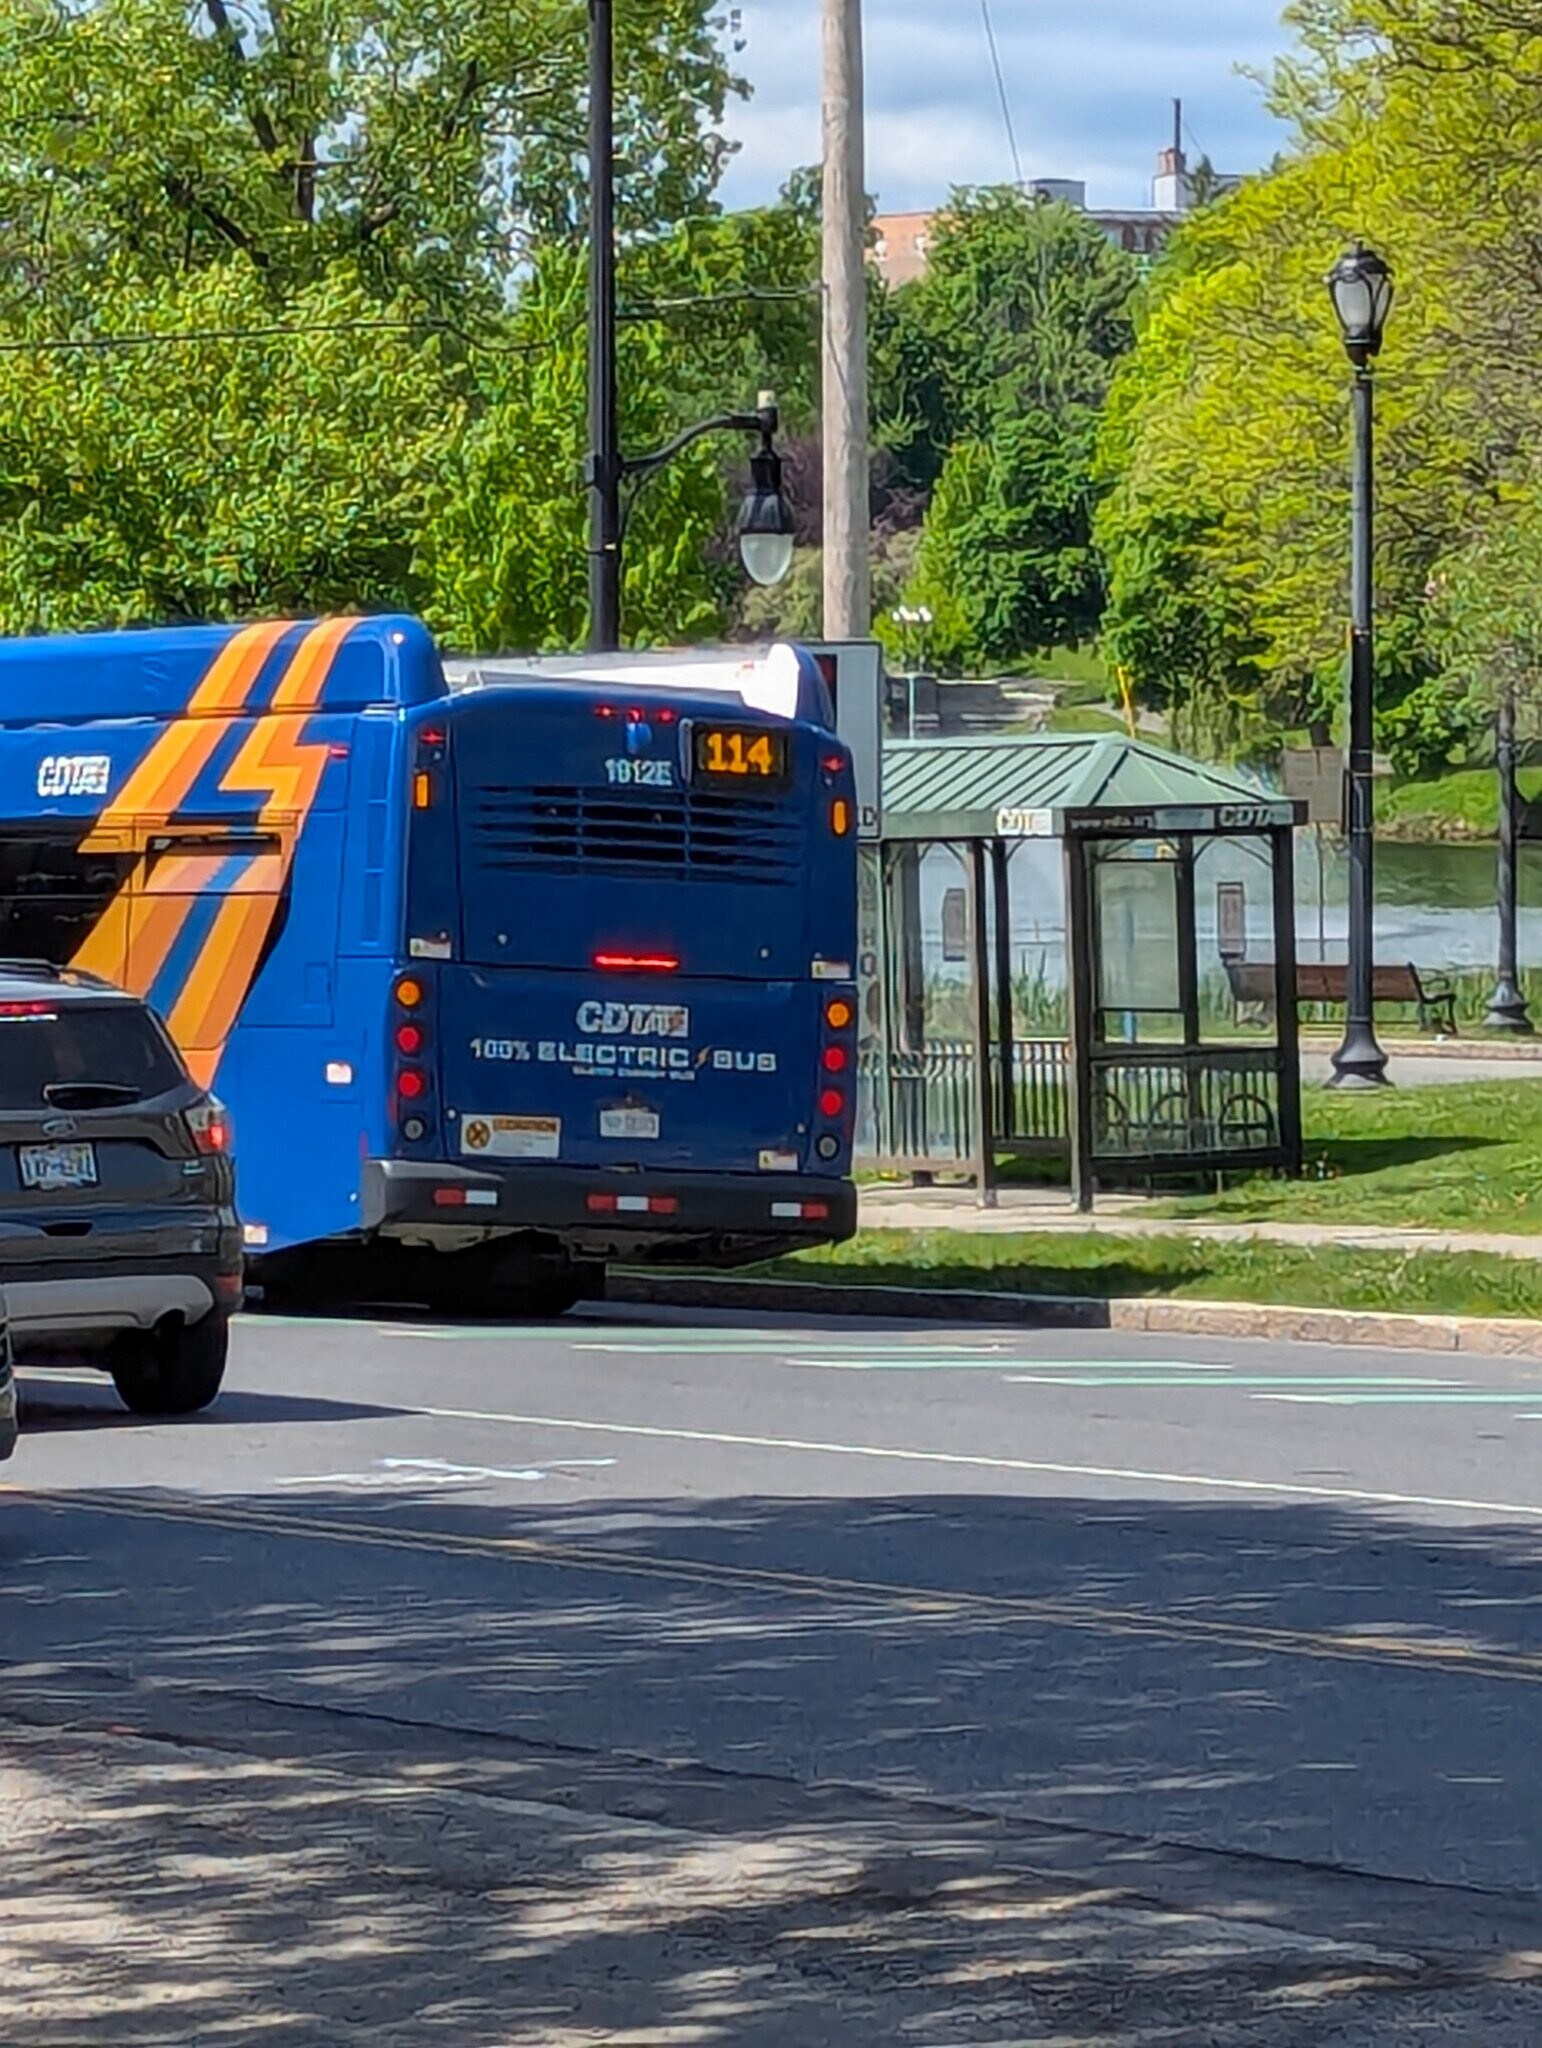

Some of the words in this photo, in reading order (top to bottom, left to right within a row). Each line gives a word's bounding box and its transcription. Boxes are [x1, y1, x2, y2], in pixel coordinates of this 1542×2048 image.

[707, 733, 772, 775] 114
[470, 1038, 530, 1061] 100%
[538, 1040, 689, 1068] ELECTRIC
[713, 1050, 776, 1072] BUS
